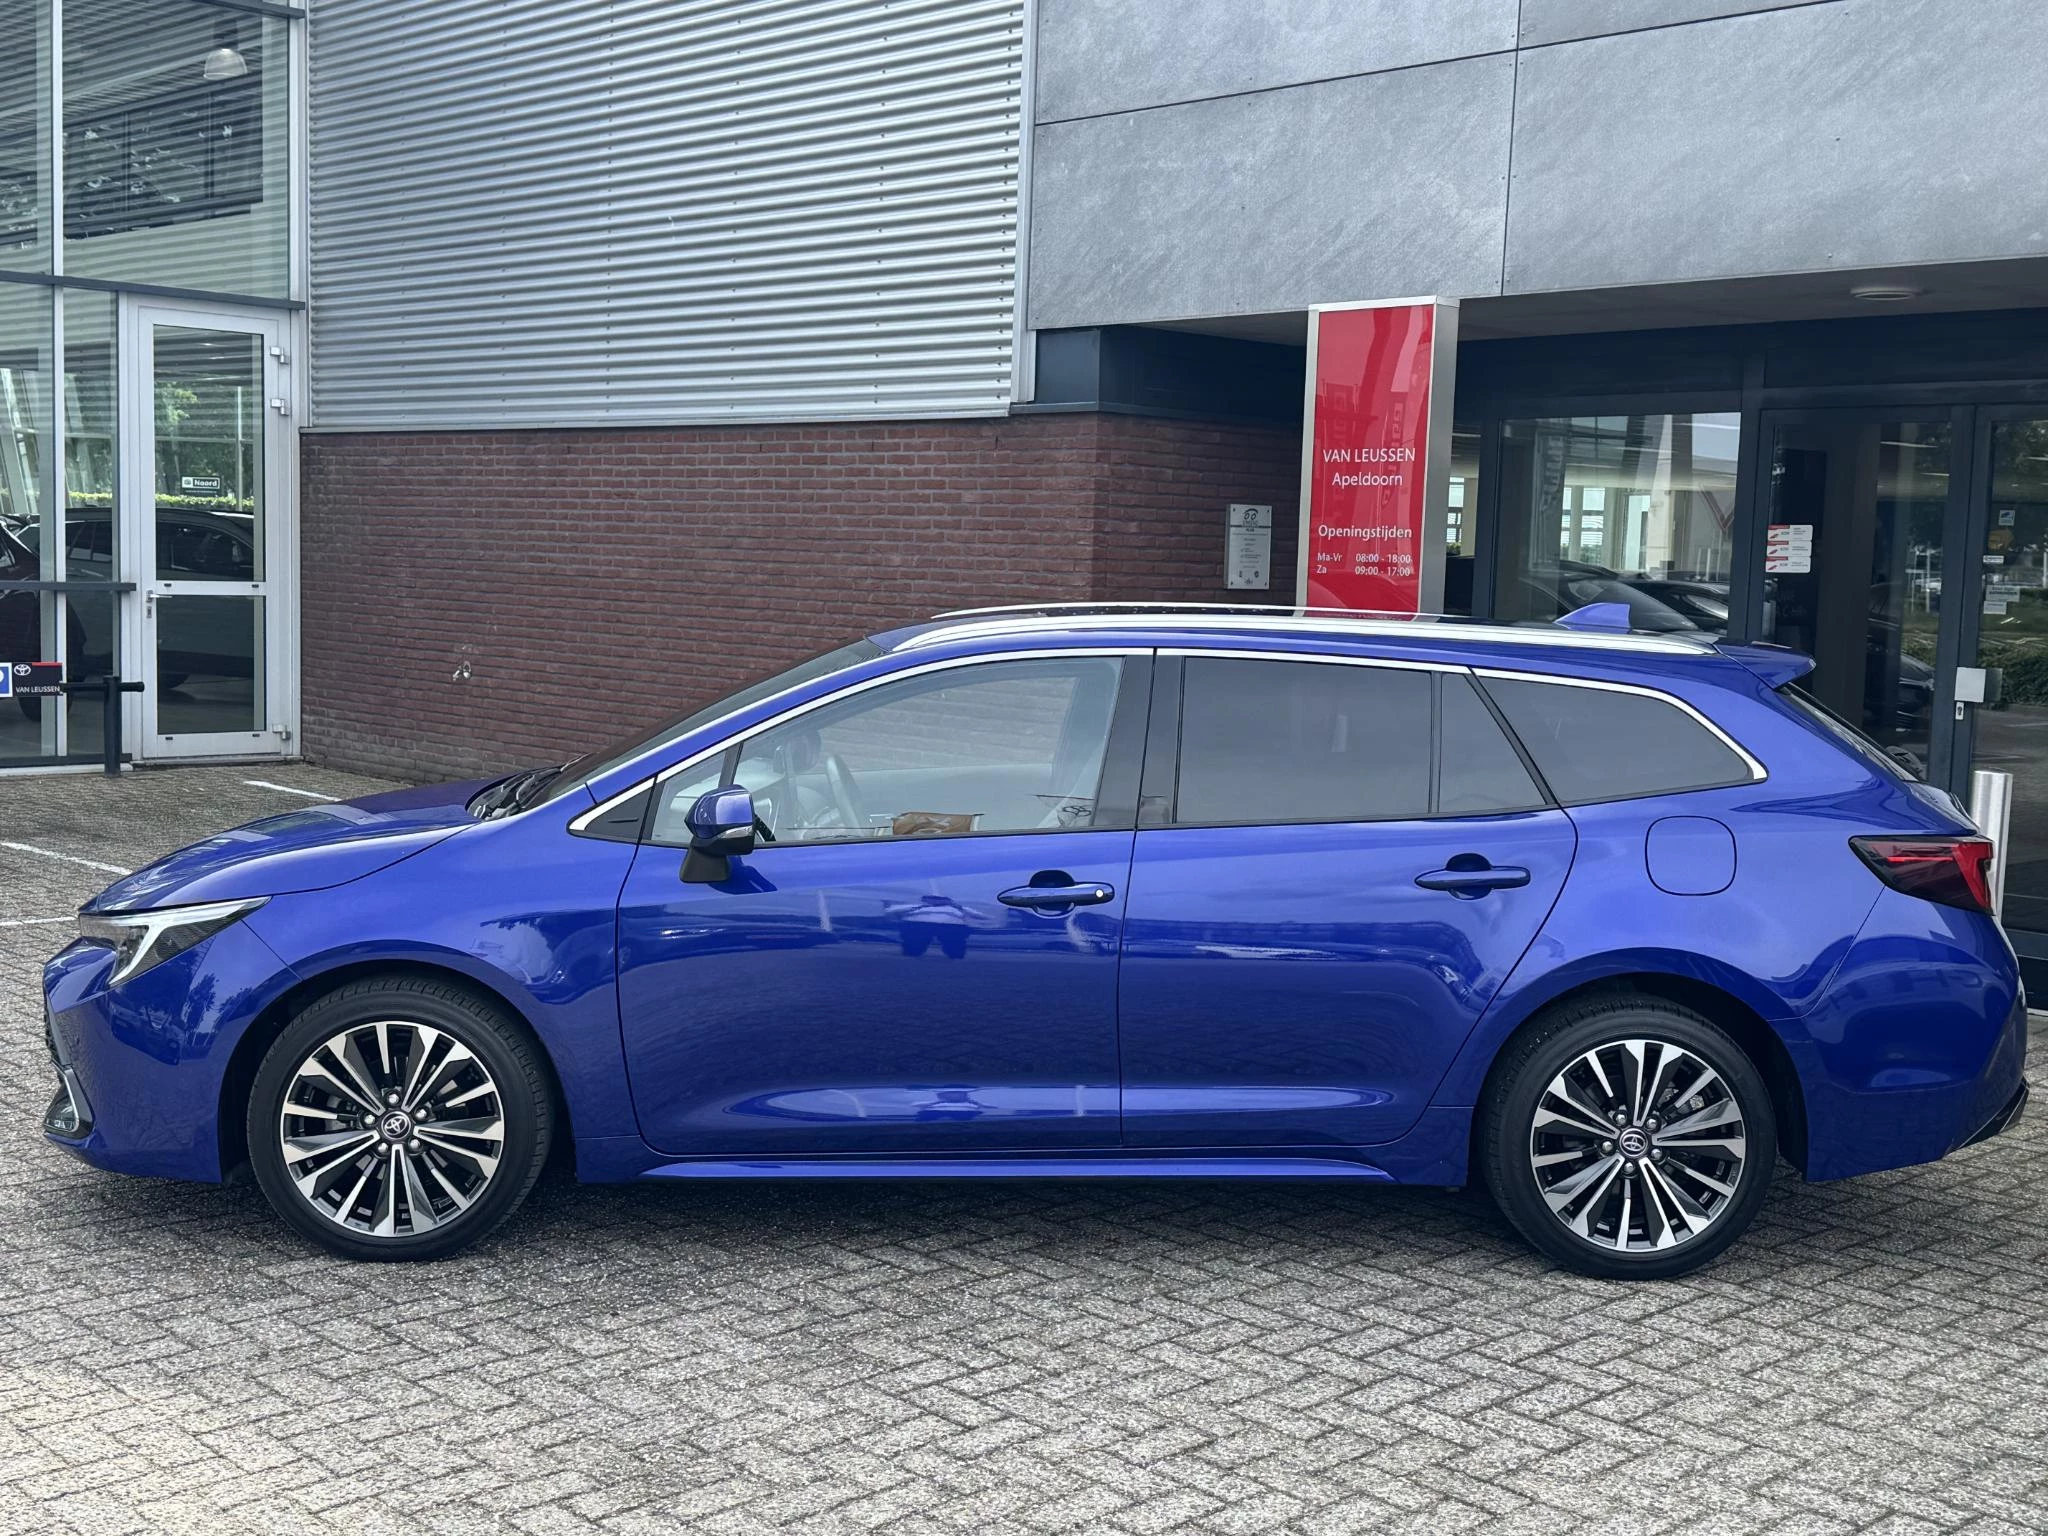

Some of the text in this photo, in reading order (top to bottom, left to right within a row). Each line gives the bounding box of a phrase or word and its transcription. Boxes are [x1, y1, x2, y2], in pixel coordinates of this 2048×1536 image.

[1323, 447, 1416, 463] VAN LEUSSEN
[194, 479, 218, 487] Noord
[1332, 471, 1403, 490] Apeldoorn
[1318, 524, 1413, 541] Openingstijden
[1317, 552, 1342, 562] Ma-Vr
[1355, 553, 1380, 563] 08:00
[1387, 553, 1412, 564] 18:00
[1316, 564, 1327, 574] Za
[1354, 565, 1379, 576] 09:00
[1387, 566, 1412, 577] 17:00
[31, 685, 60, 693] LEUSSEN
